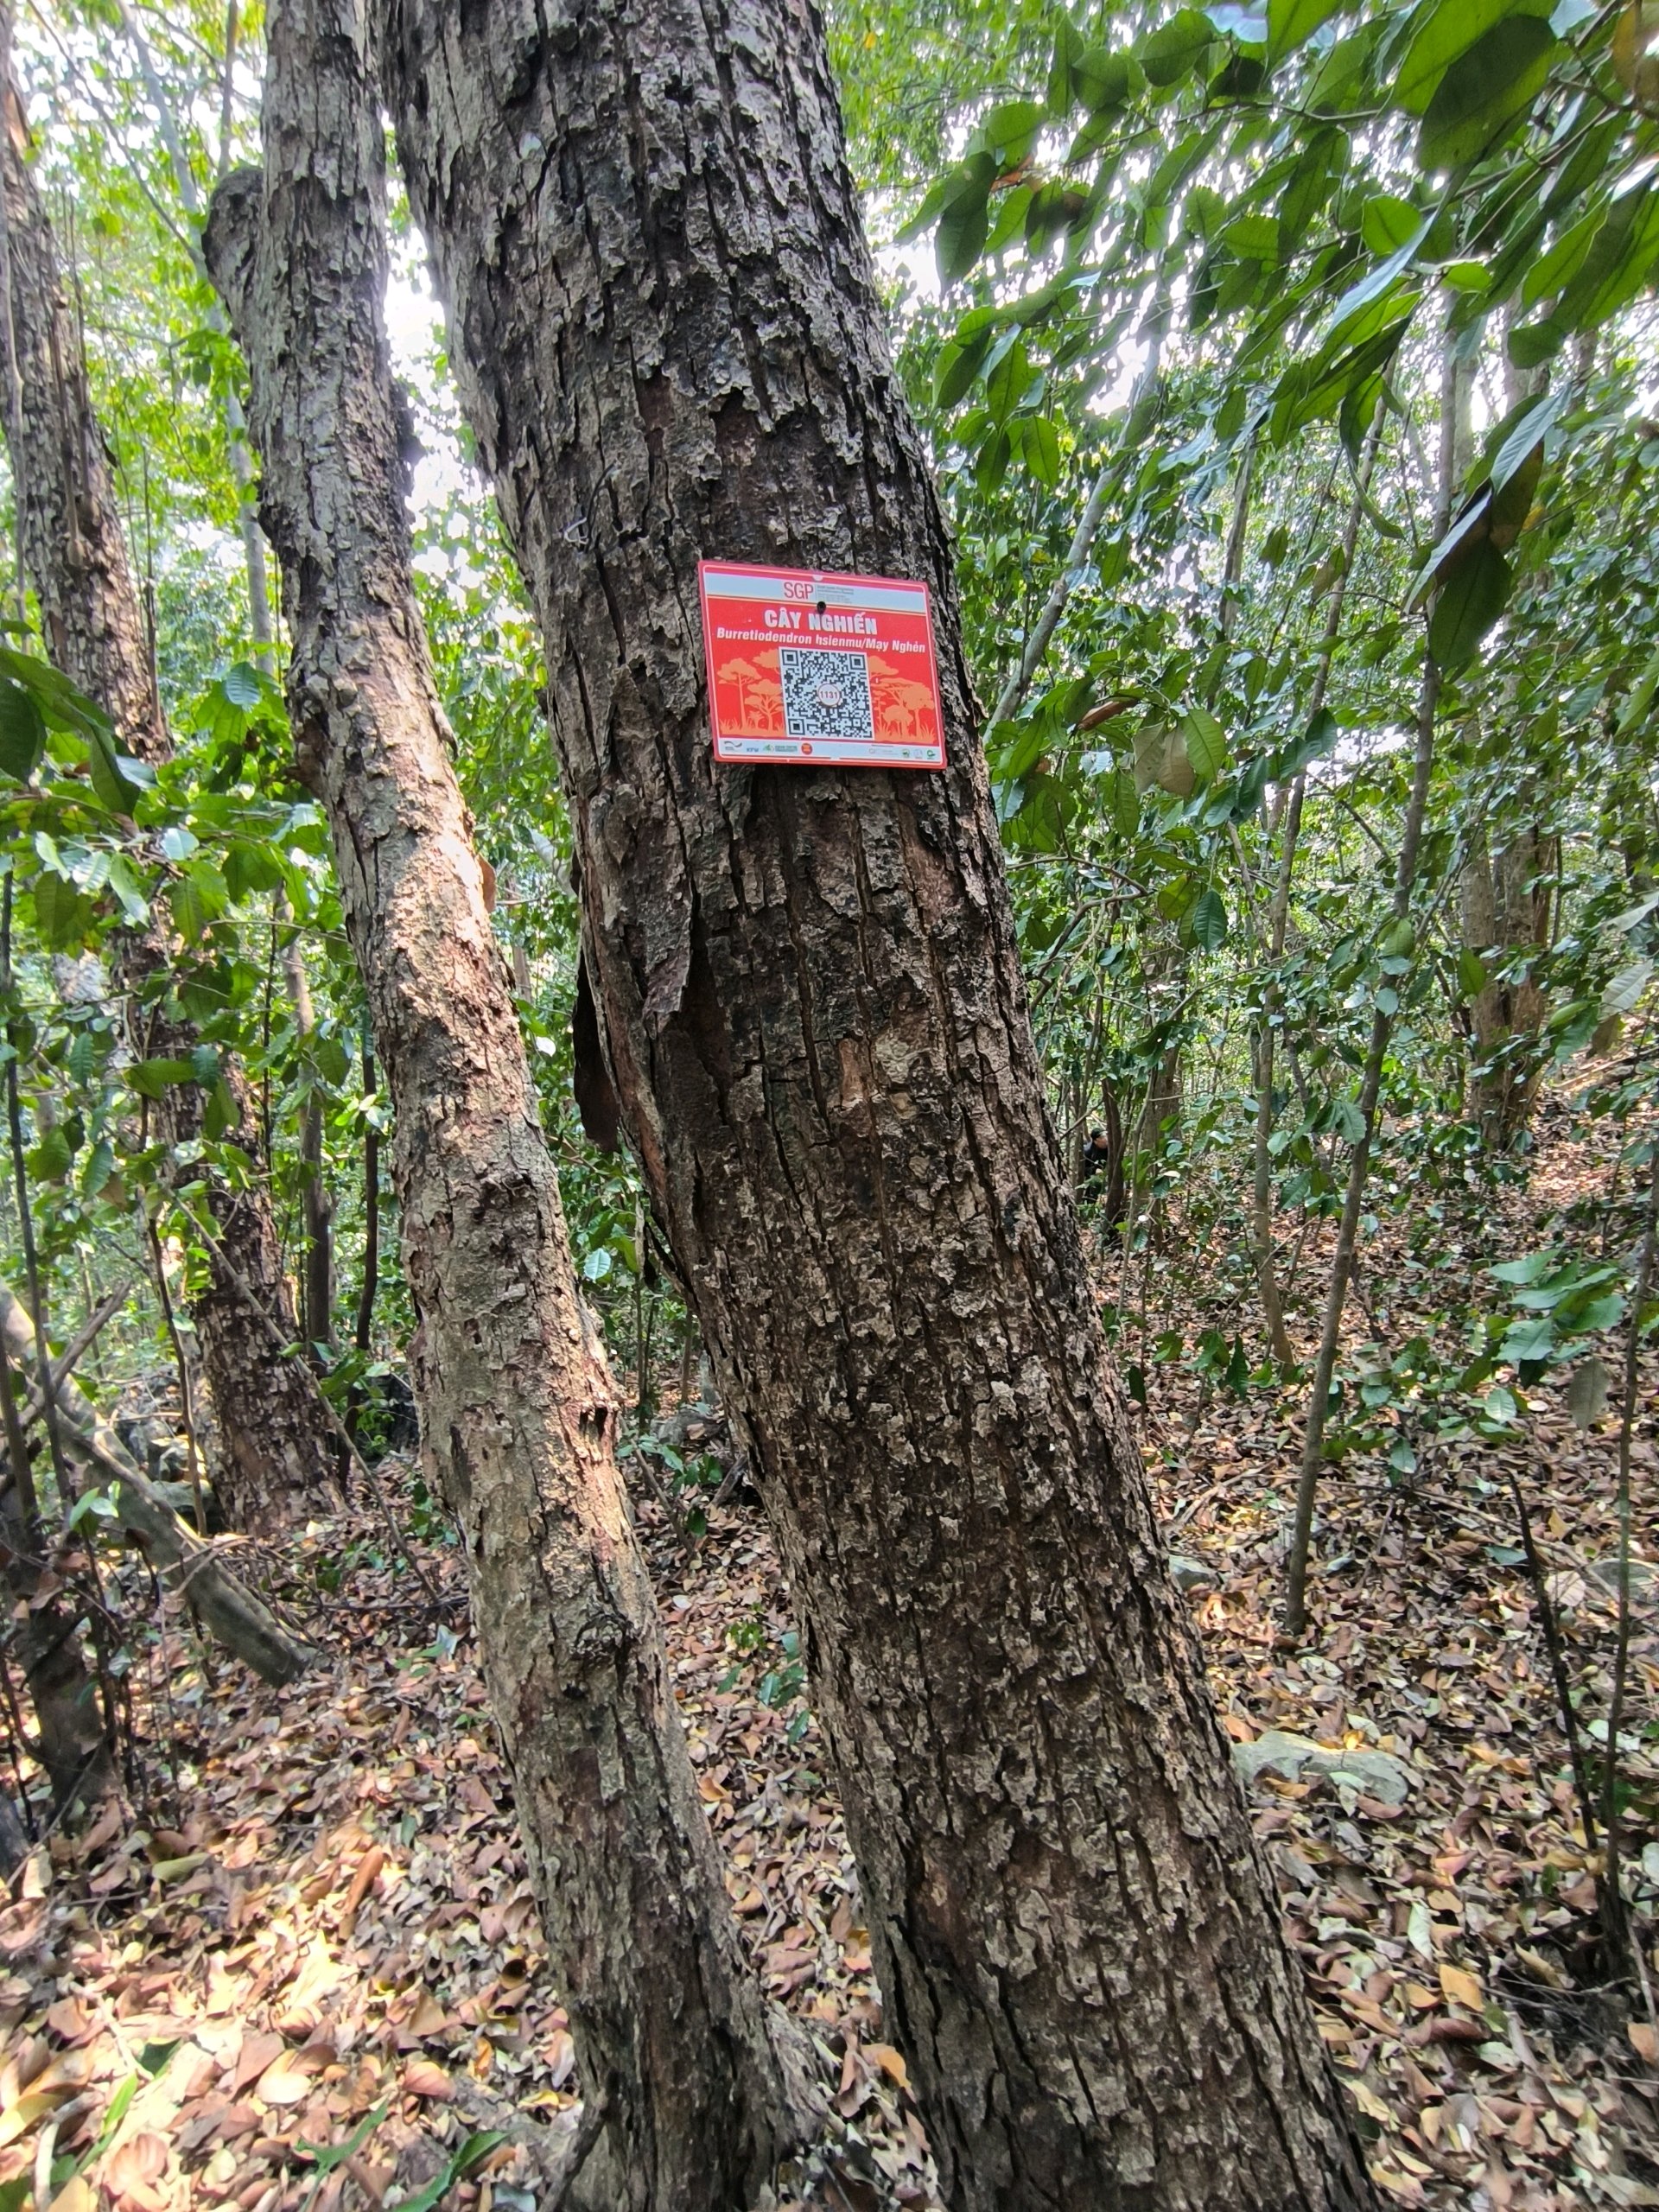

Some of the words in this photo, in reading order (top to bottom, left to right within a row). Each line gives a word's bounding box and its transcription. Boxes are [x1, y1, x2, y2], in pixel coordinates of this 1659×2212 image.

[784, 582, 814, 600] SGP
[764, 607, 801, 630] CÂY
[809, 612, 878, 635] NGHIẾN
[717, 627, 812, 645] Burretiodendron
[820, 690, 838, 699] 1131
